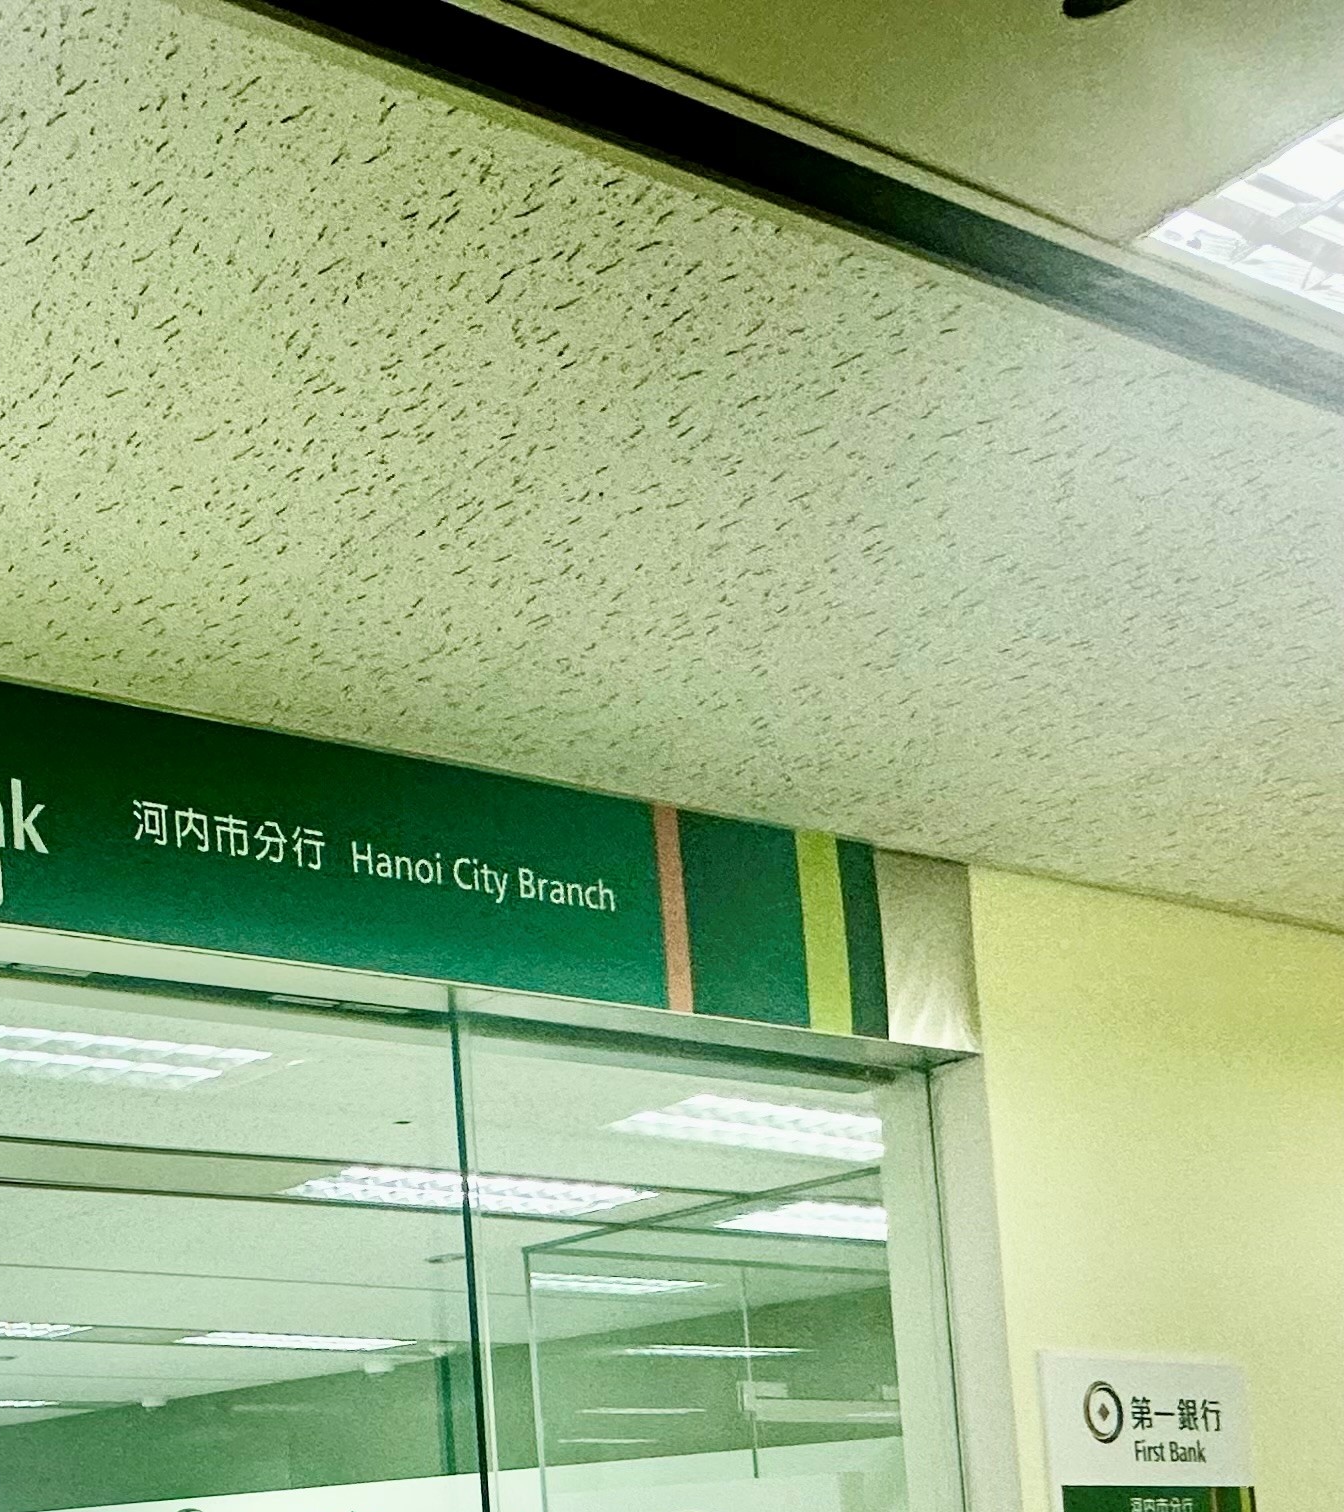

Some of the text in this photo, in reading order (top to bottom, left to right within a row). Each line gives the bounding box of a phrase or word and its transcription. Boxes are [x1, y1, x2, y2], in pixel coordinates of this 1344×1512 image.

[351, 840, 442, 884] Hanoi
[453, 858, 509, 903] City
[518, 867, 616, 912] Branch
[1130, 1396, 1222, 1432] 第一銀行
[1134, 1440, 1207, 1463] First Bank
